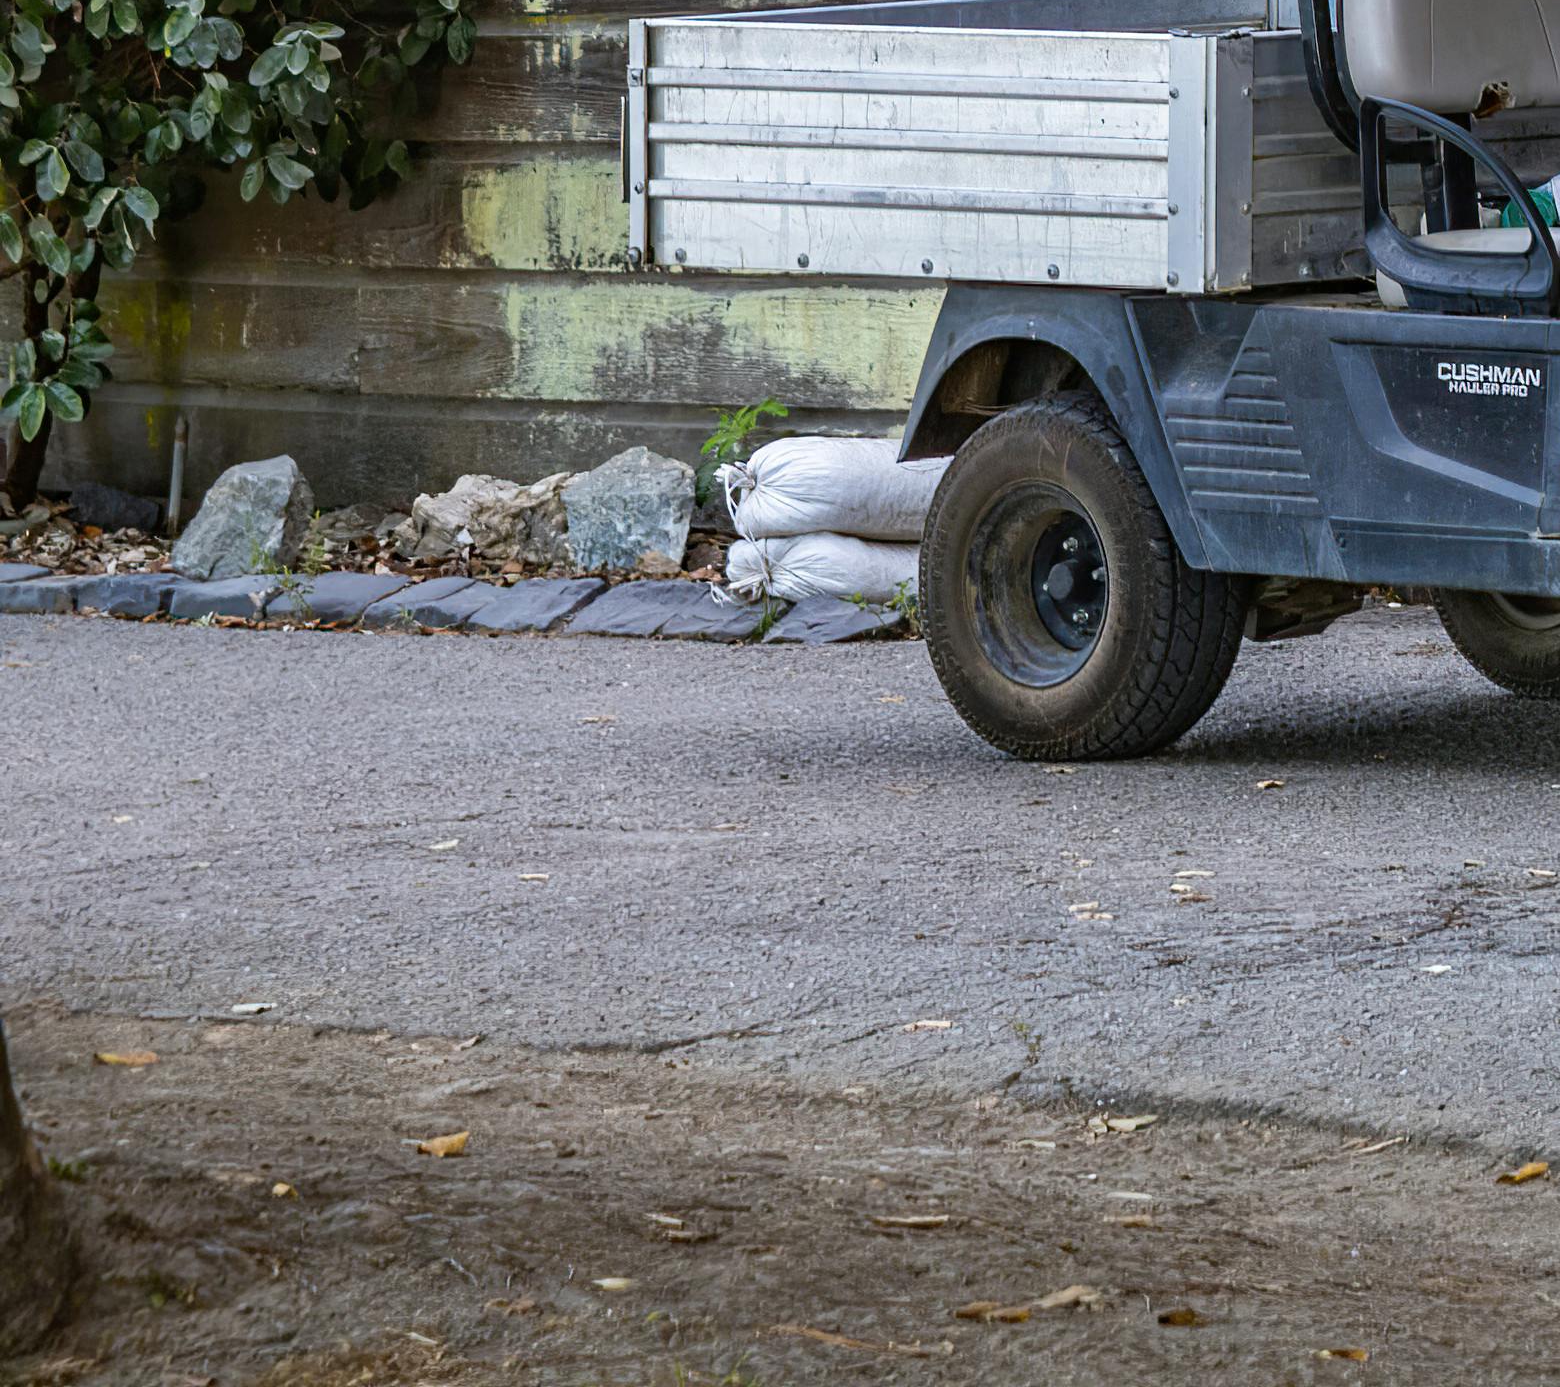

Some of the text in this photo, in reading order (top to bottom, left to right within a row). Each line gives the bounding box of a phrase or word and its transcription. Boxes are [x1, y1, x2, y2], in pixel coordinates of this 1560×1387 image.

[1437, 362, 1541, 387] CUSHMAN
[1448, 381, 1528, 397] HAULER PRO
